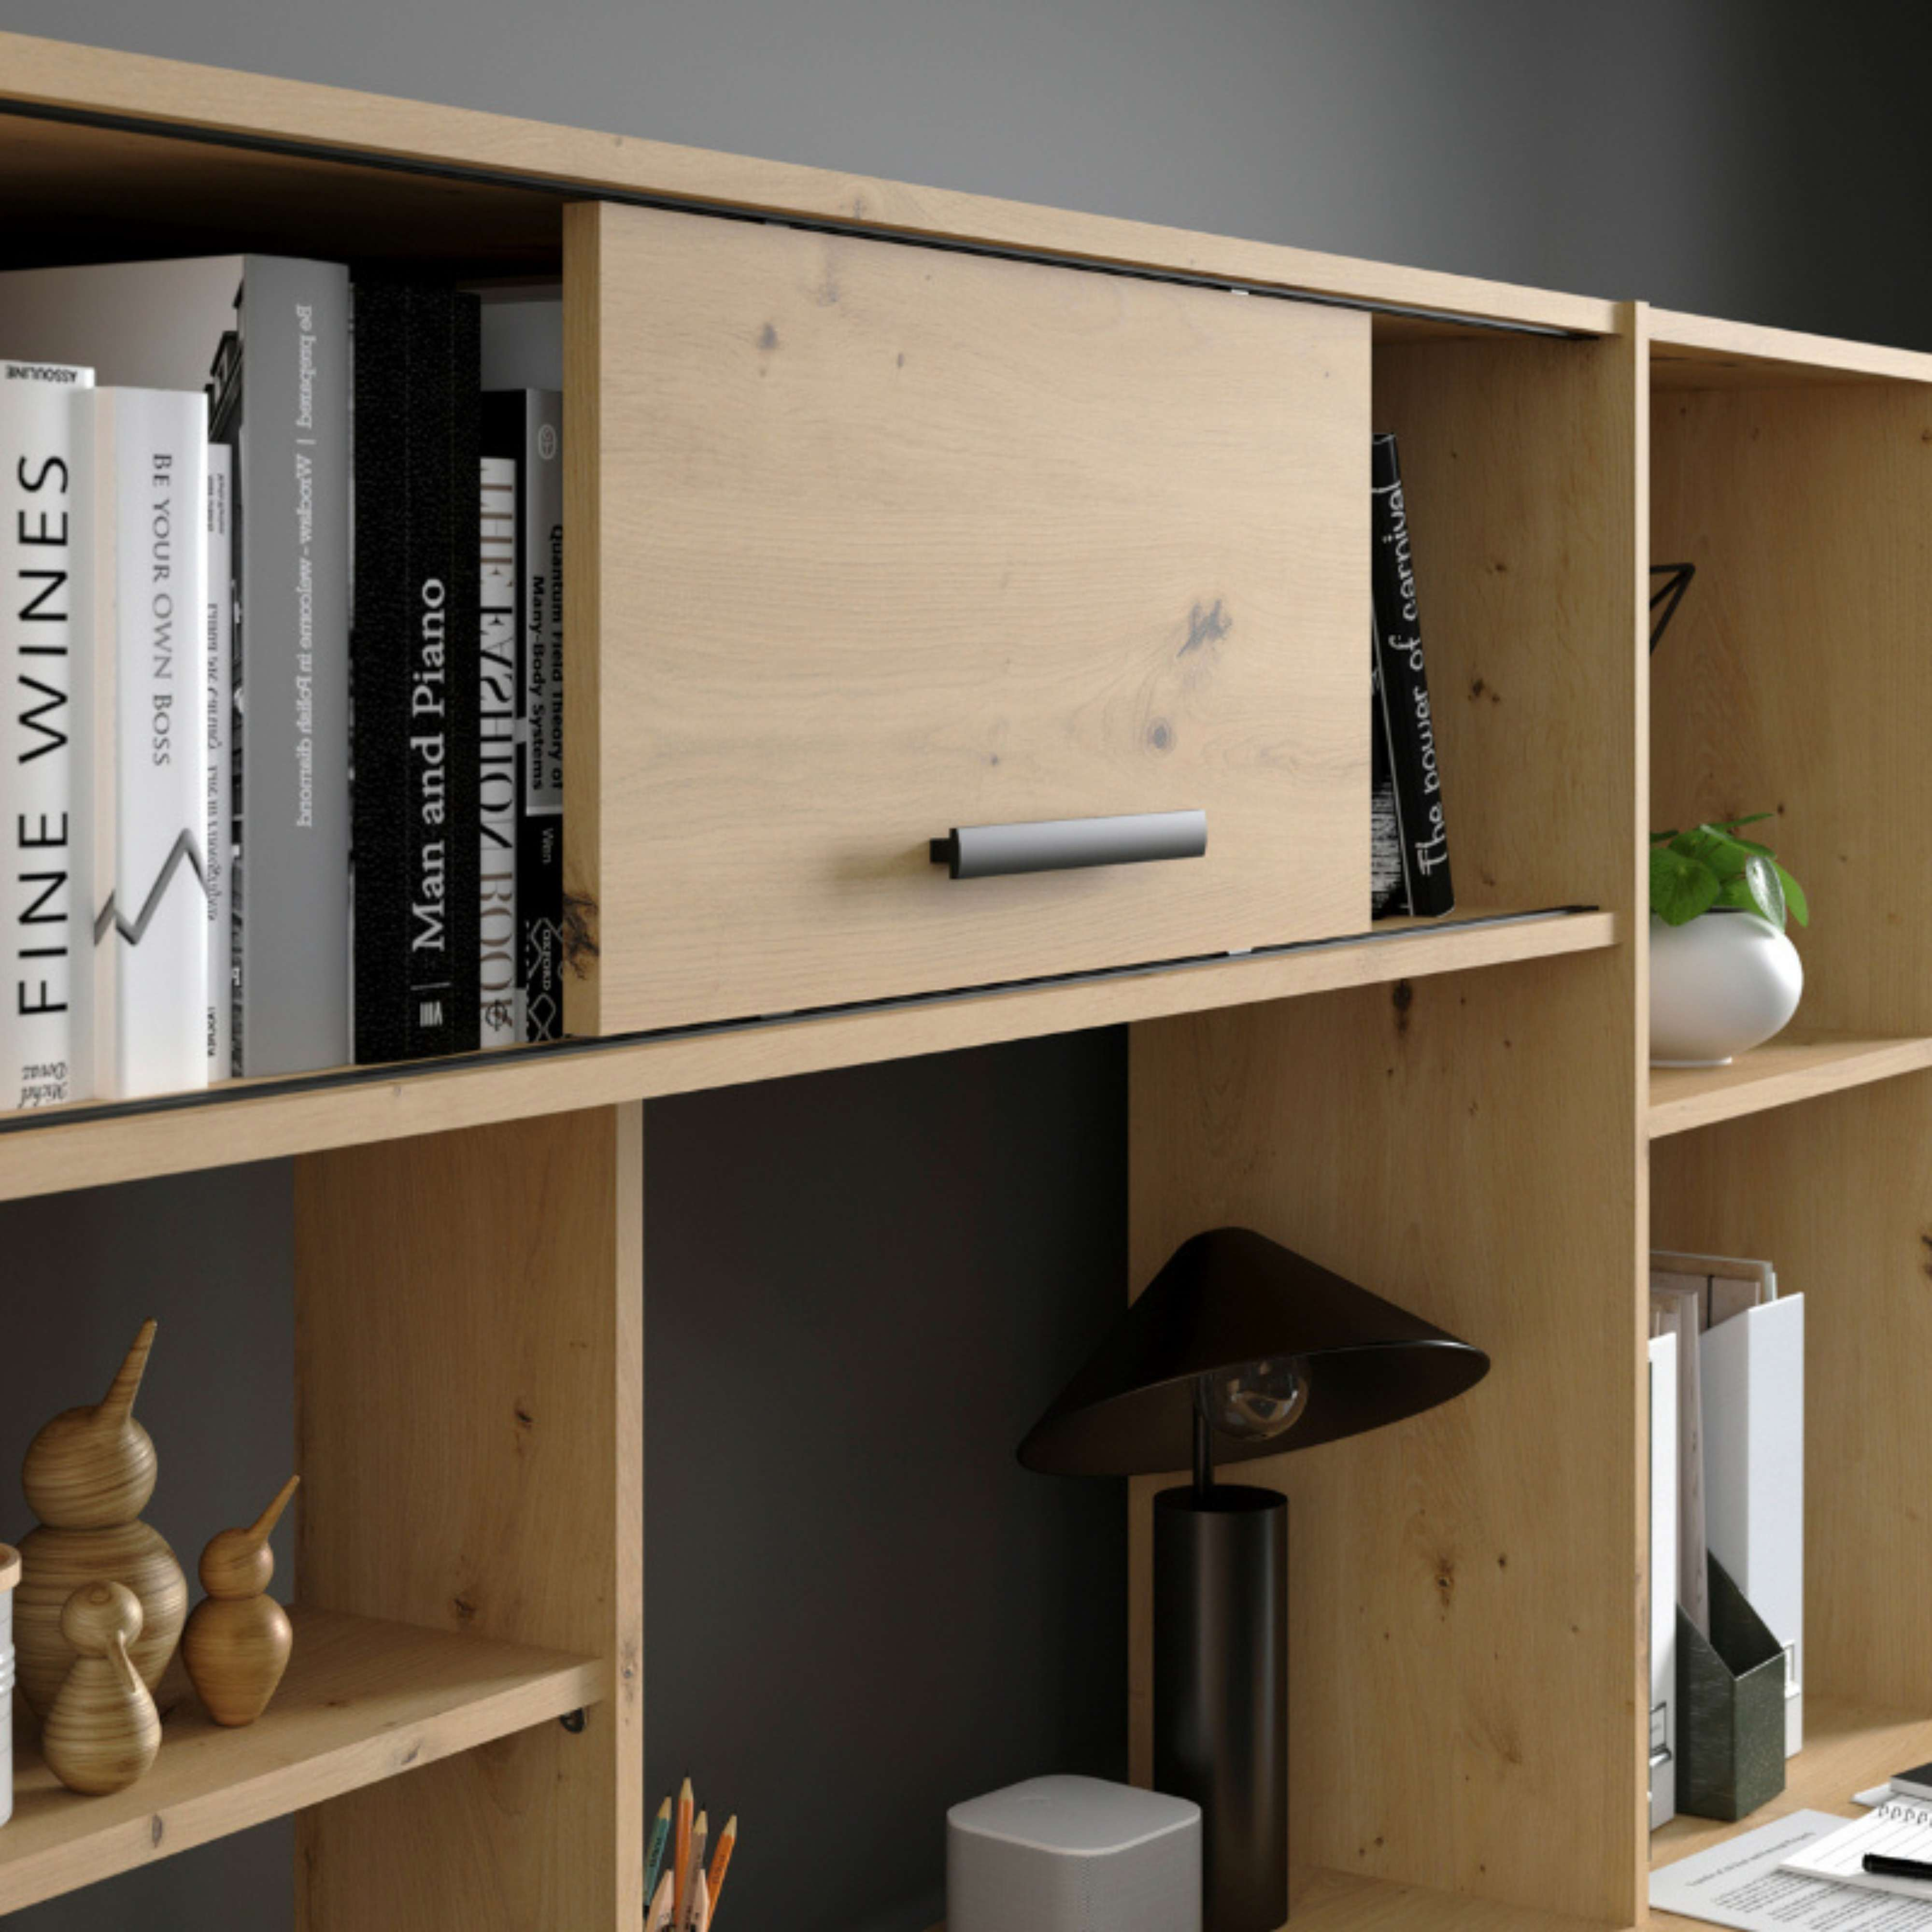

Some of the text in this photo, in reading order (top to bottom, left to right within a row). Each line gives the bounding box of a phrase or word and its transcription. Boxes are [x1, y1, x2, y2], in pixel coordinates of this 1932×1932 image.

[17, 456, 69, 1016] FINE WINES
[152, 453, 173, 767] BE YOUR OWN BOSS
[529, 576, 547, 791] Many-Body Systems
[1387, 634, 1423, 671] of
[410, 578, 445, 952] Man and Piano
[1414, 801, 1448, 876] The
